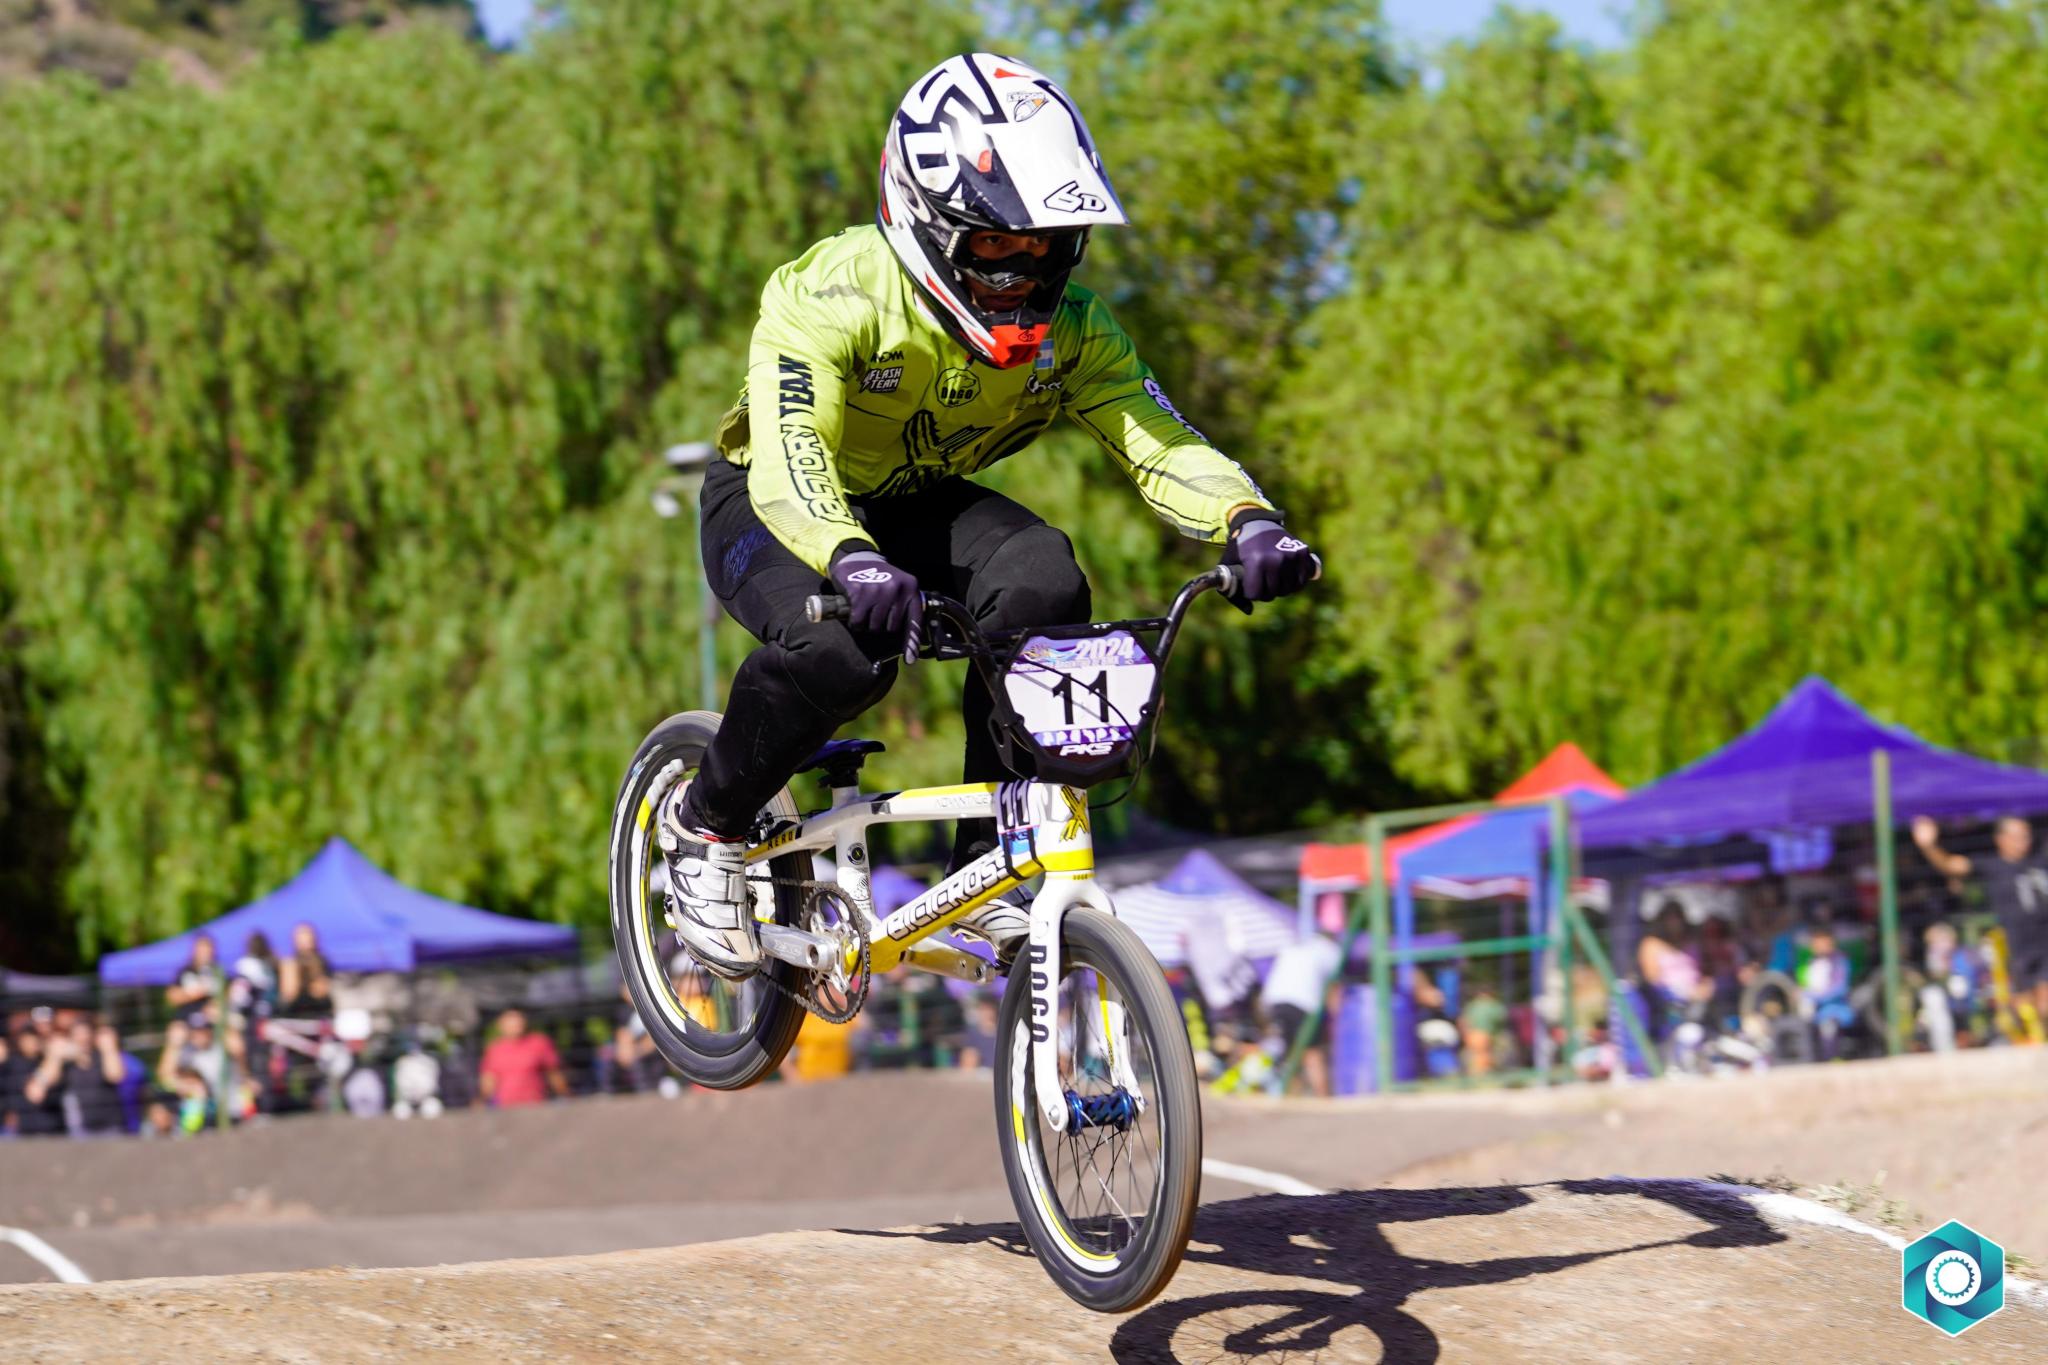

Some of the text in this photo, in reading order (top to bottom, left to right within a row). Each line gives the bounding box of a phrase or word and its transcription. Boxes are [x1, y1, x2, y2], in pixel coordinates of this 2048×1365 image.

[869, 367, 903, 380] FLASH
[870, 379, 899, 389] TEAM
[778, 354, 816, 418] TEAM
[1075, 637, 1135, 660] 2024
[1052, 670, 1109, 725] 11
